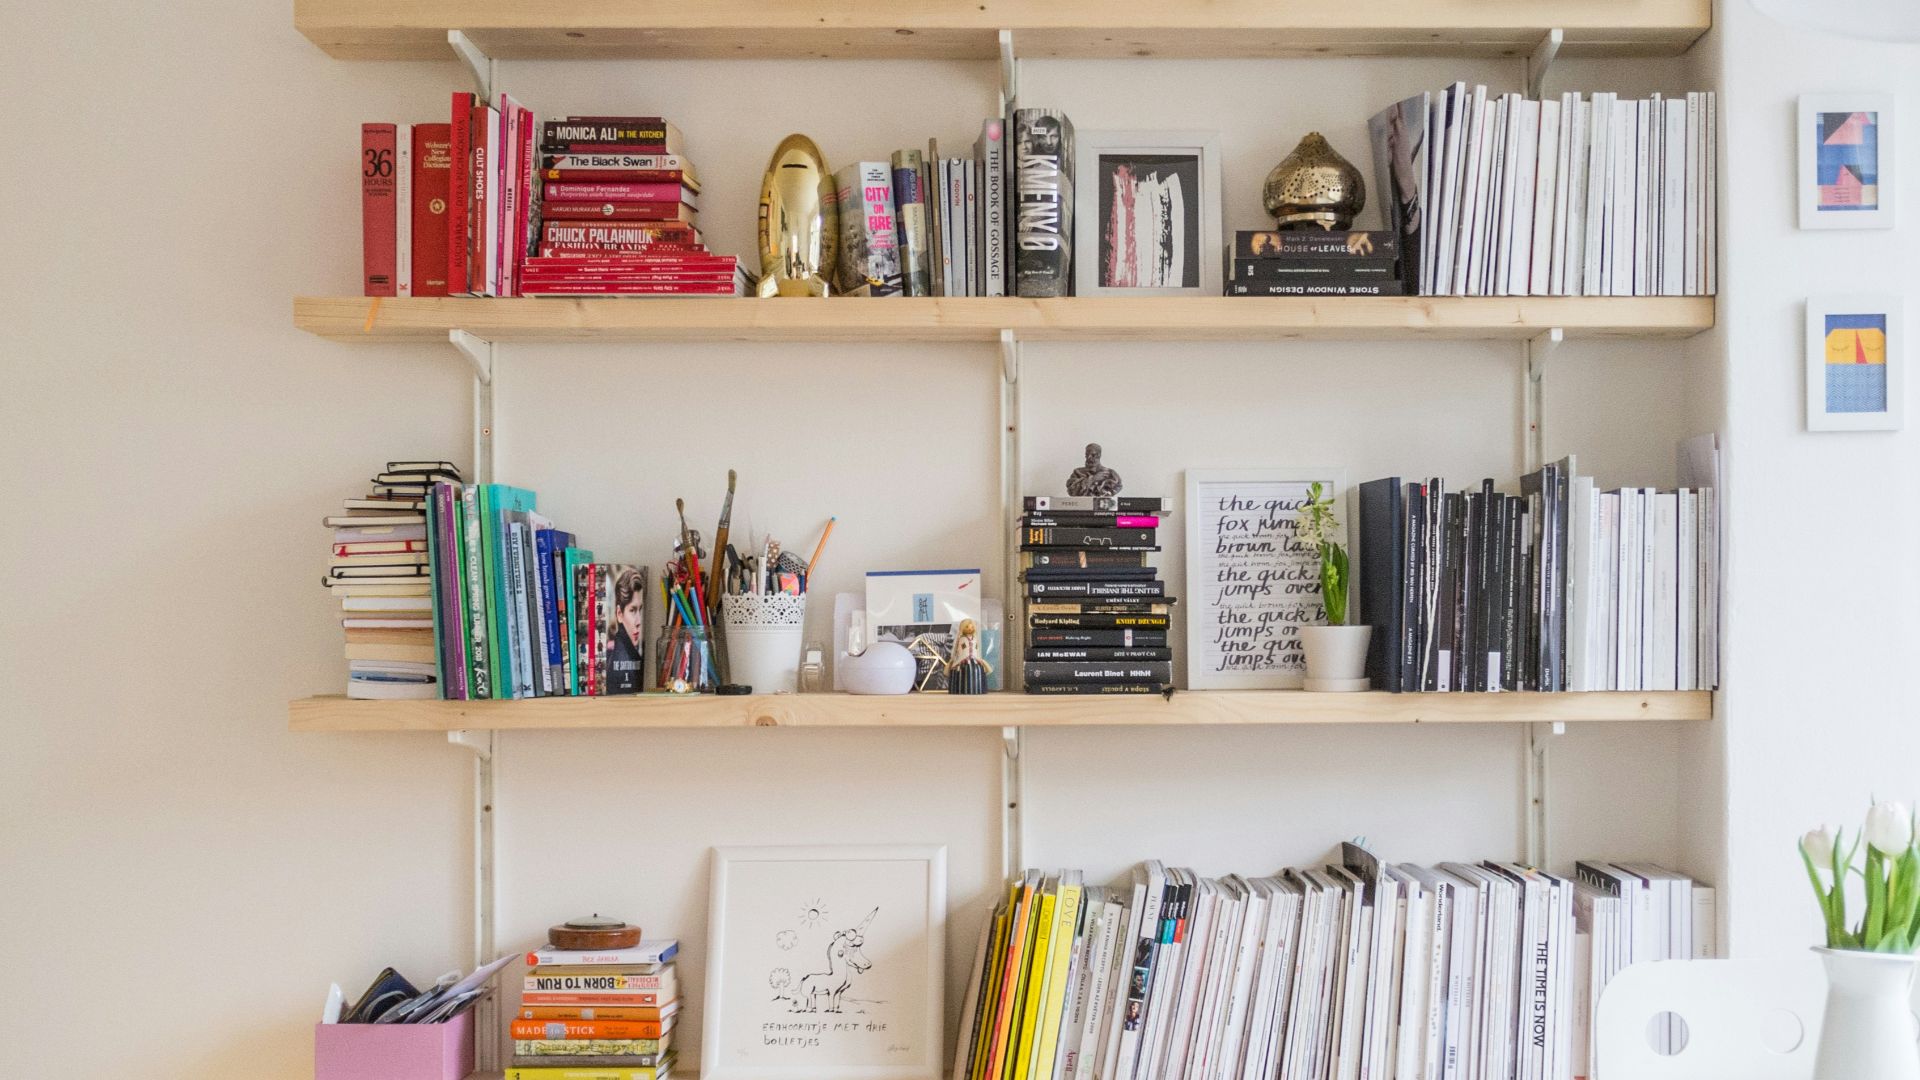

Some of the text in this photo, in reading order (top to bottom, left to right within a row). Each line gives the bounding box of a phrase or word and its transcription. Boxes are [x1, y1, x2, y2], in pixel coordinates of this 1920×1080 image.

[556, 126, 597, 140] MONICA
[600, 126, 617, 141] ALI
[639, 130, 664, 139] KITCHEN
[365, 149, 392, 177] 36
[569, 156, 652, 167] The Black Swan
[475, 148, 484, 200] CULT SHOES
[560, 185, 595, 194] Dominique
[865, 187, 890, 202] CITY
[1020, 155, 1058, 233] KMENY
[873, 203, 885, 214] ON
[990, 149, 1000, 280] THE BOOK OF GOSSAGE
[868, 216, 892, 231] FIRE
[548, 227, 653, 244] CHUCK PALAHNIUK
[554, 241, 647, 251] FASHION BRANDS
[1278, 245, 1309, 253] HOUSE
[1318, 245, 1352, 253] LEAVES
[1269, 286, 1379, 294] STORE WINDOW DESIGN
[1218, 495, 1261, 511] the
[1217, 515, 1249, 534] fox
[512, 546, 522, 590] FURNITURE
[541, 565, 549, 584] brands
[1217, 566, 1314, 591] the quick
[471, 583, 479, 610] SPRING
[1211, 584, 1273, 606] jumps
[473, 612, 481, 642] SUMMER
[1058, 618, 1080, 626] Kipling
[1217, 608, 1310, 633] the quick
[1214, 625, 1274, 643] jumps
[1221, 640, 1303, 660] the quic
[1216, 653, 1306, 671] jumps ove
[1061, 889, 1076, 928] LOVE
[537, 977, 615, 990] BORN TO RUN
[1532, 940, 1548, 1047] THE TIME IS NOW
[516, 1026, 547, 1035] MADE
[563, 1026, 595, 1034] STICK
[834, 1022, 859, 1032] MET
[1063, 1048, 1076, 1072] Apetit
